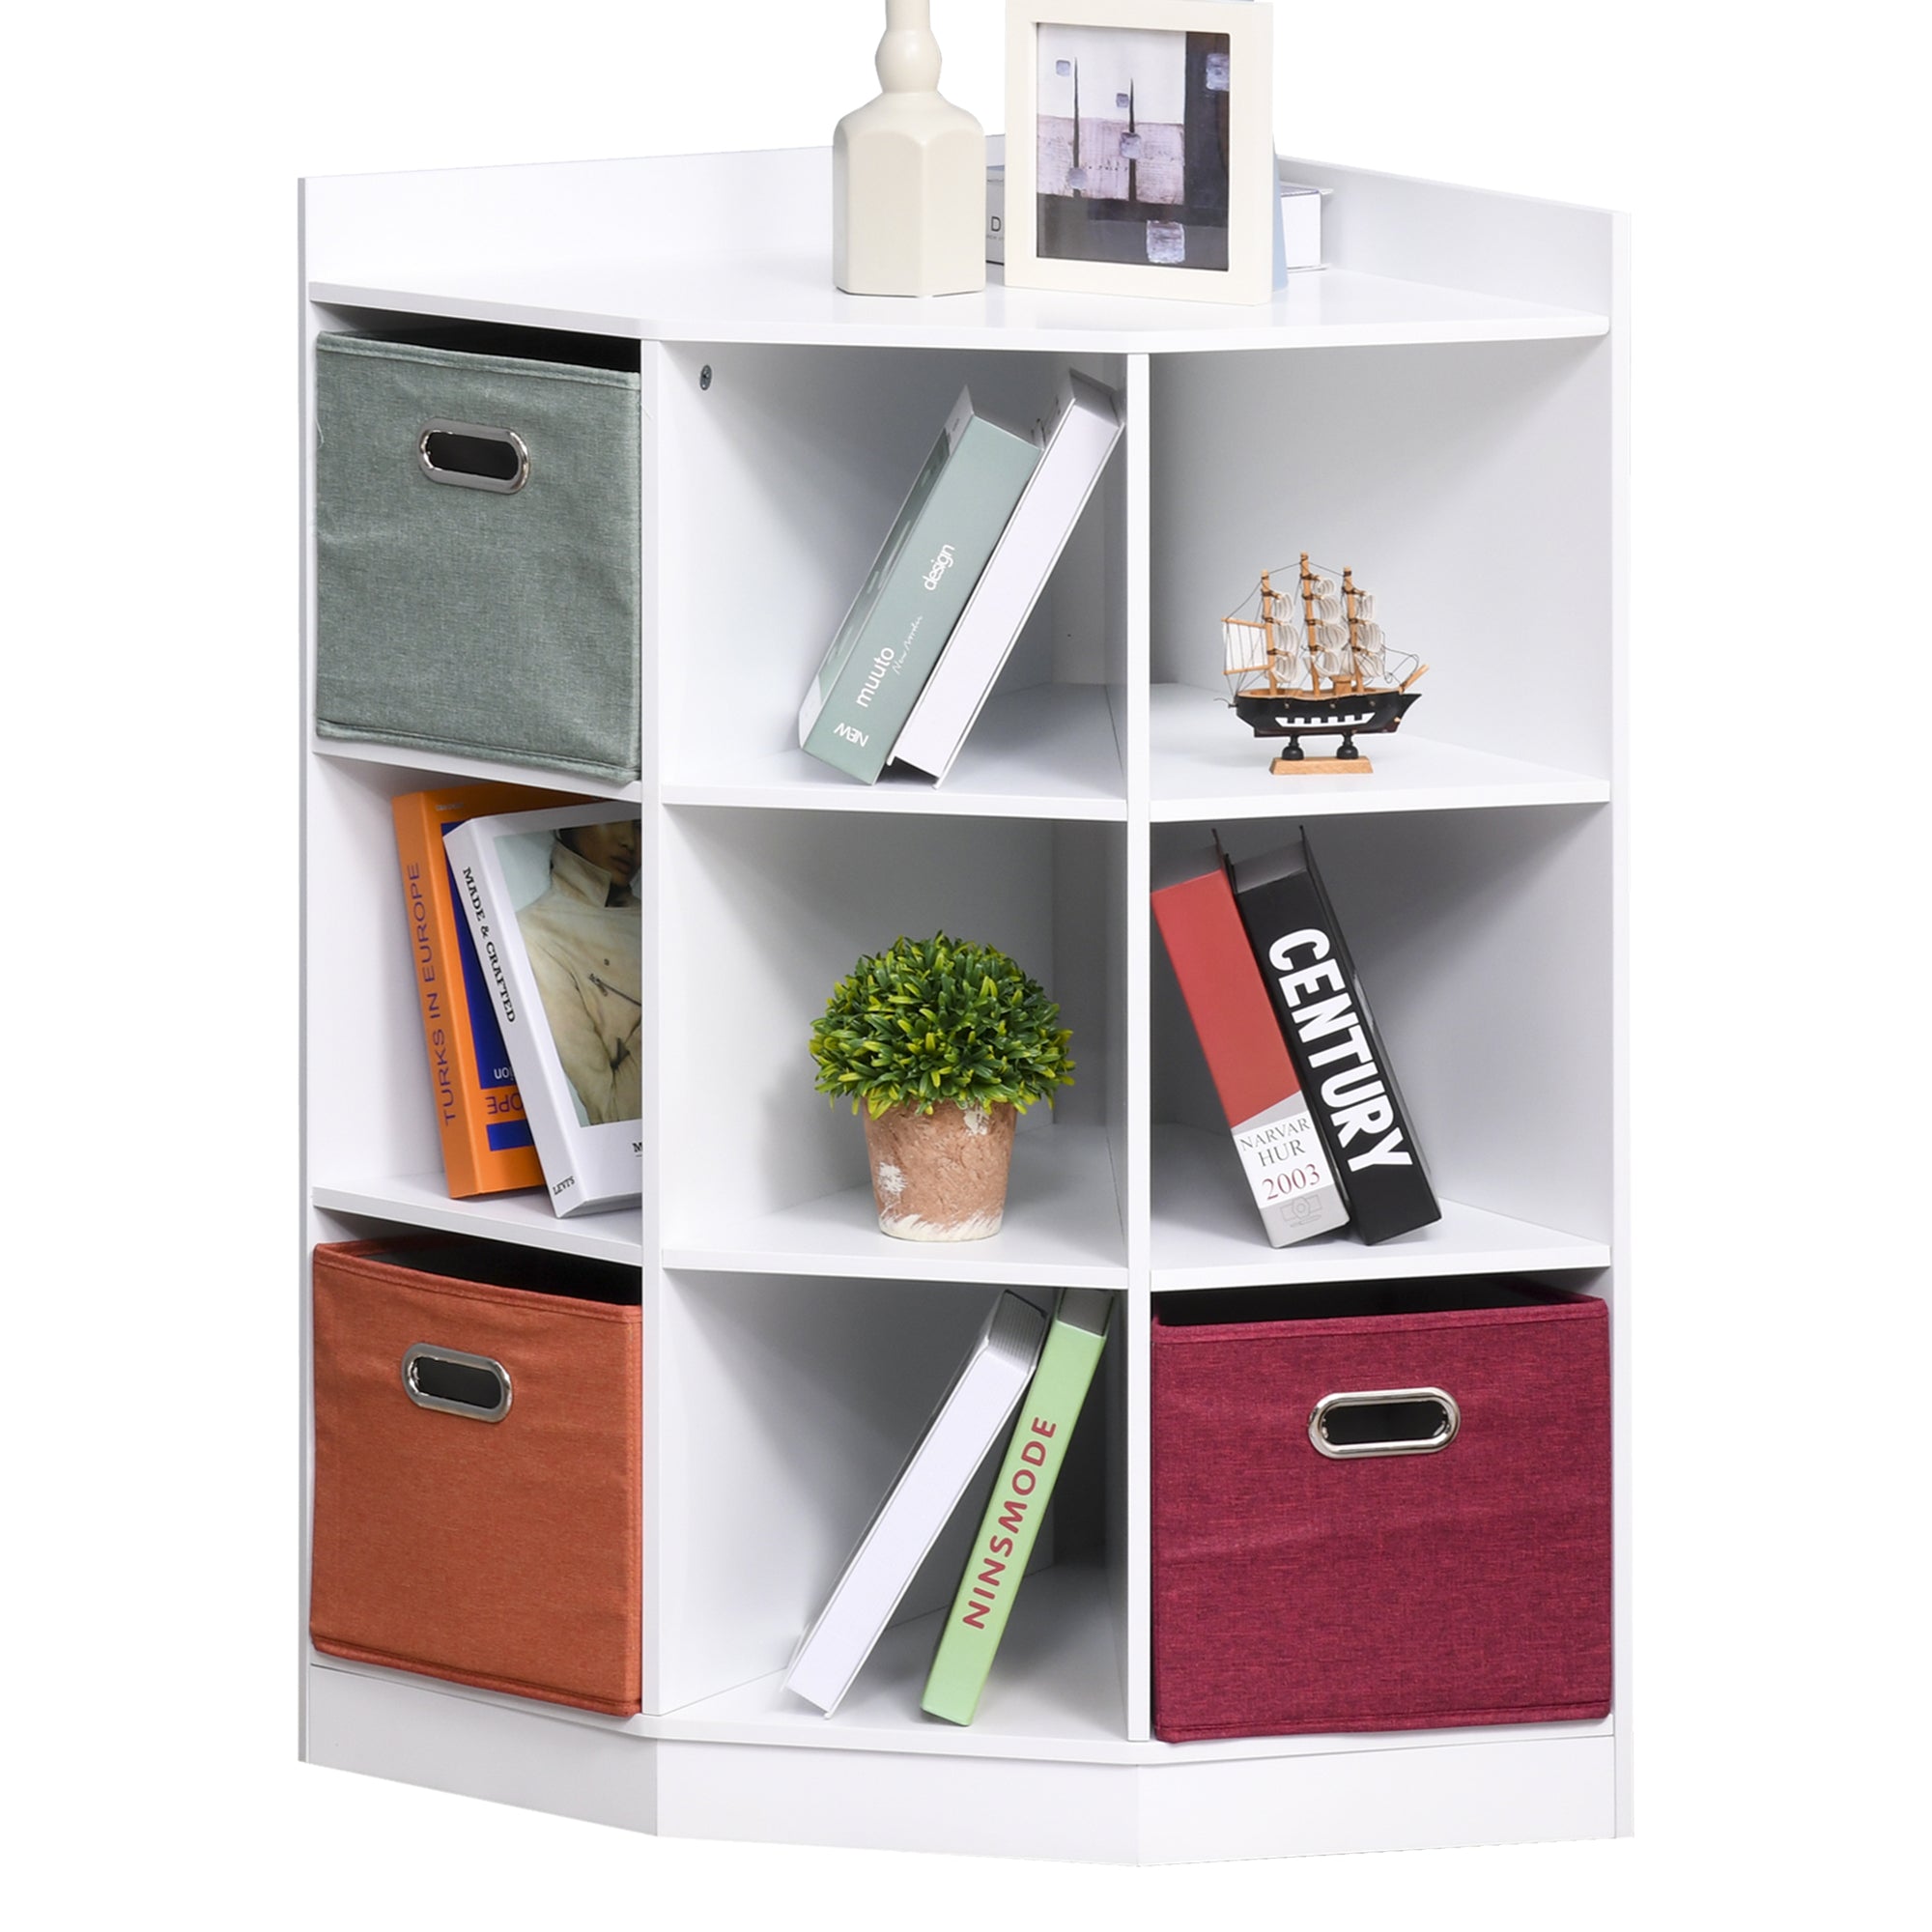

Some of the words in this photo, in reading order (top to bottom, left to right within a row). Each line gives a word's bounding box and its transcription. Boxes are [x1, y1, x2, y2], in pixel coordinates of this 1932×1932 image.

[856, 647, 895, 708] muuto
[923, 544, 955, 591] design
[834, 723, 868, 748] NEW
[407, 863, 436, 983] EUROPE
[463, 867, 486, 923] MADE
[480, 924, 490, 939] &
[486, 941, 516, 1023] CRAFTED
[426, 992, 441, 1019] IN
[1268, 927, 1413, 1172] CENTURY
[432, 1028, 456, 1126] TURKS
[1239, 1118, 1311, 1151] NARVAR
[1258, 1139, 1306, 1167] HUR
[1262, 1163, 1321, 1201] 2003
[962, 1416, 1057, 1630] NINSMODE
